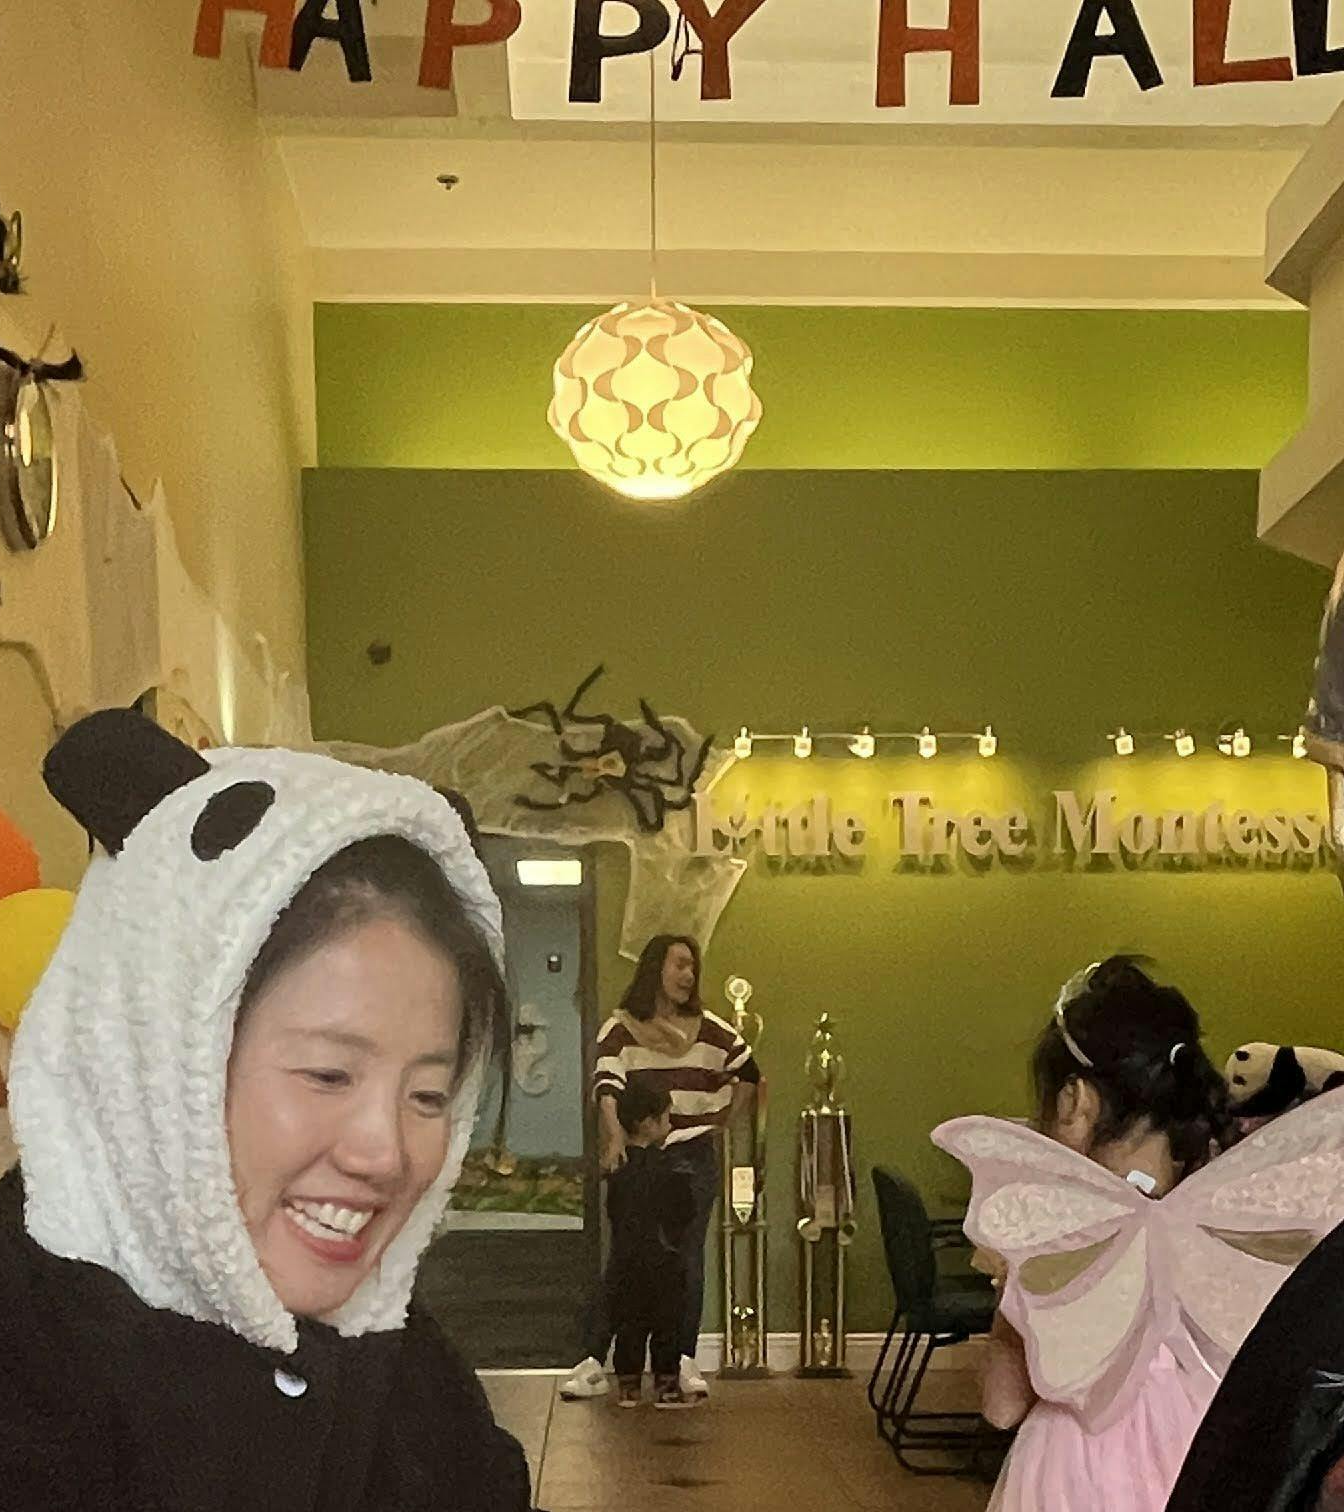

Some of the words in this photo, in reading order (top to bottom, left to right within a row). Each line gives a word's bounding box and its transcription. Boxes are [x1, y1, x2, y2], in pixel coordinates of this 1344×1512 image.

[193, 0, 756, 104] HAPPY
[888, 791, 1028, 856] Tree
[1052, 791, 1336, 854] Montess
